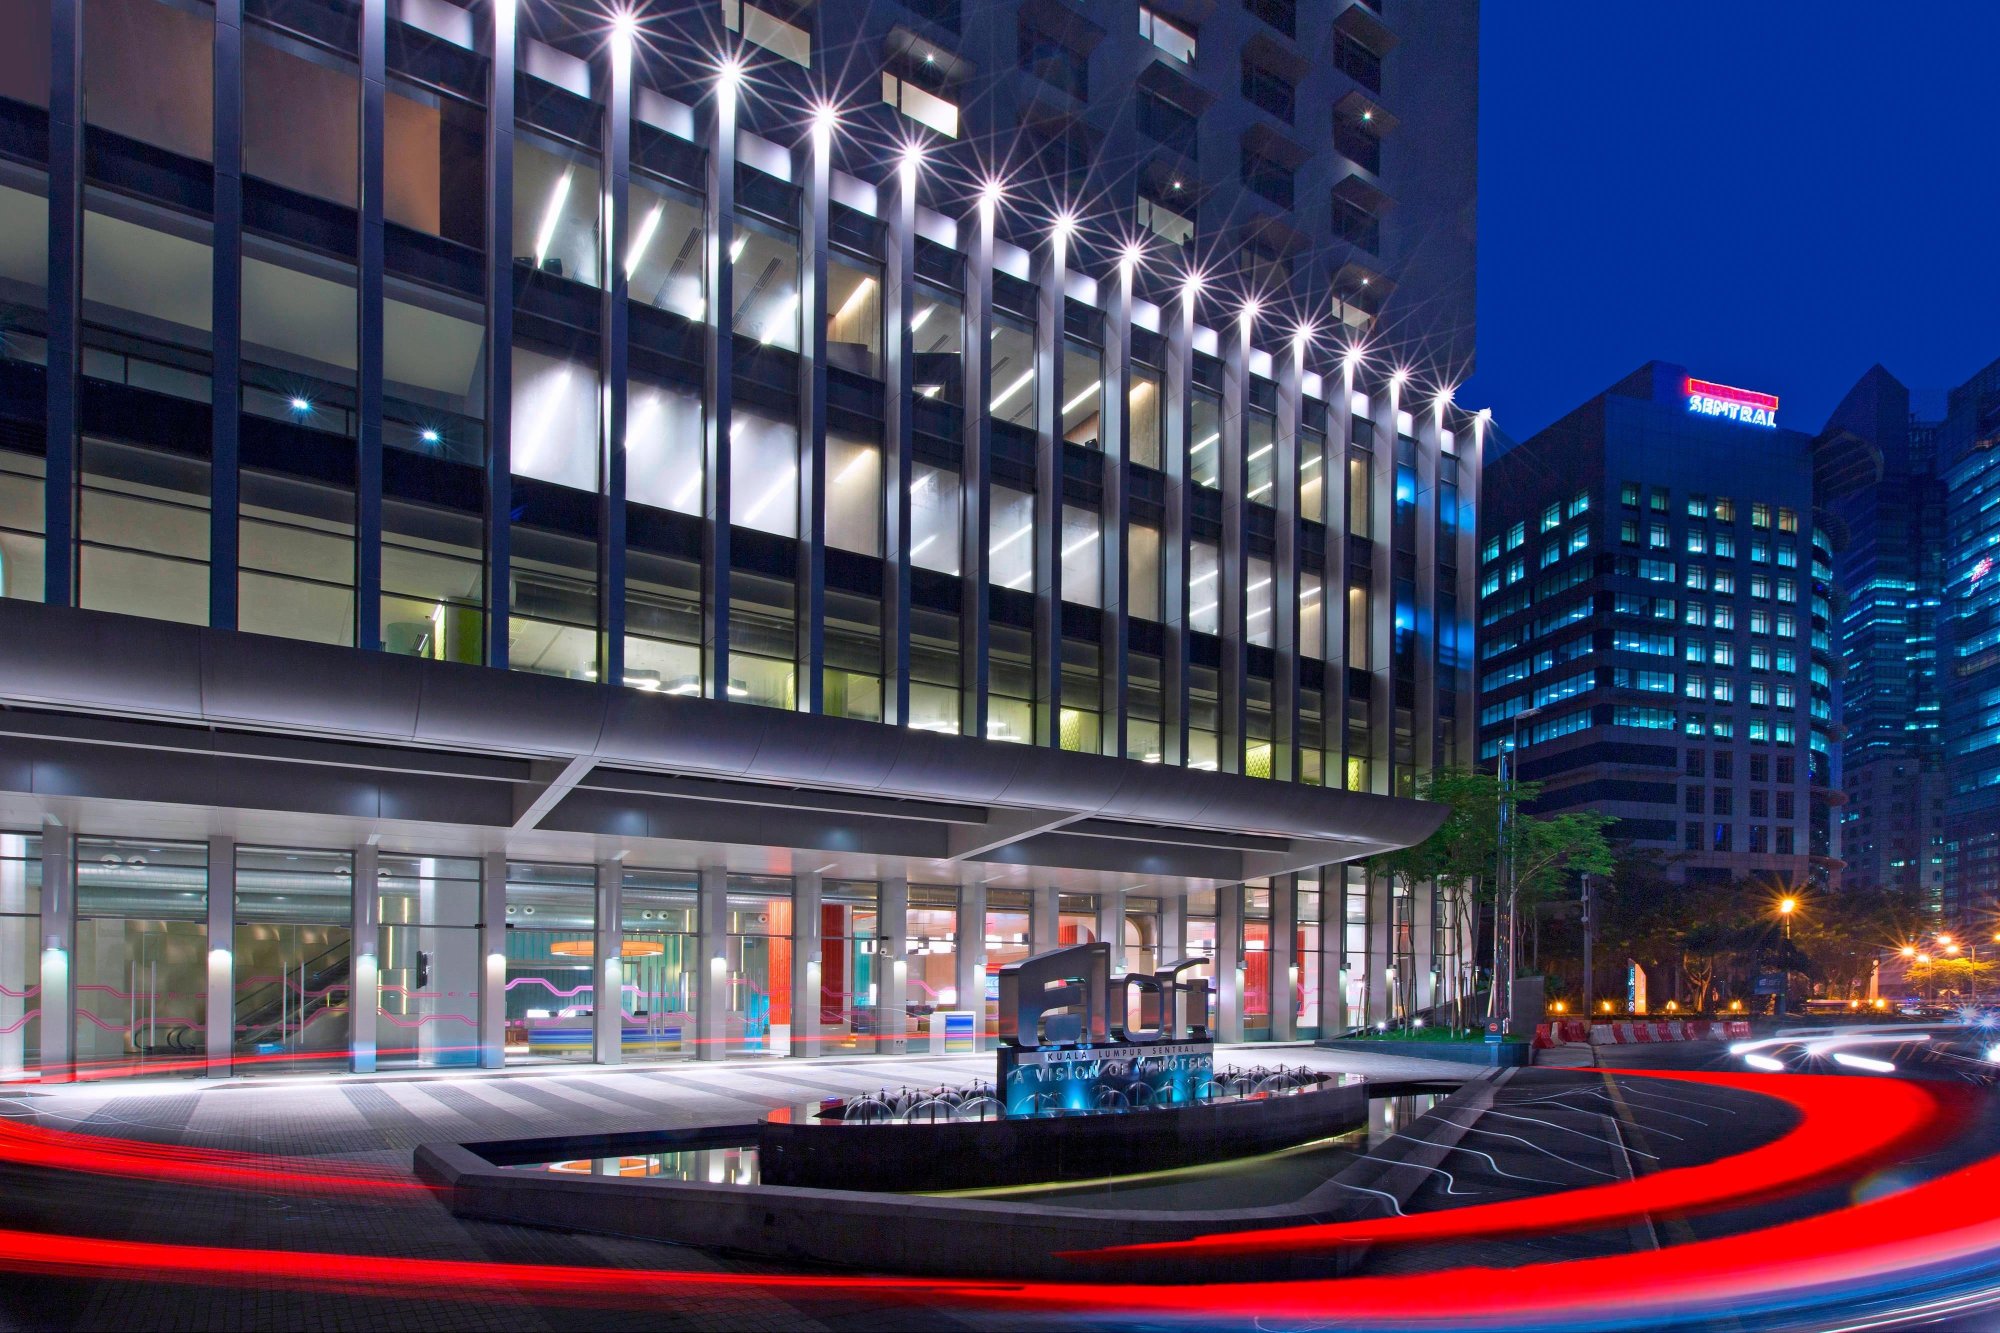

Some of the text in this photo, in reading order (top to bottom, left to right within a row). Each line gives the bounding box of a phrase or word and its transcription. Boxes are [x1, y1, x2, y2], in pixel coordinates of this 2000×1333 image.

[1689, 395, 1777, 428] SENTRAL
[1047, 1045, 1195, 1061] KUALA LUMPUR SENTRAL
[1014, 1070, 1024, 1084] A
[1036, 1064, 1099, 1082] VISION
[1109, 1063, 1129, 1076] OF
[1158, 1057, 1212, 1072] HOTELS
